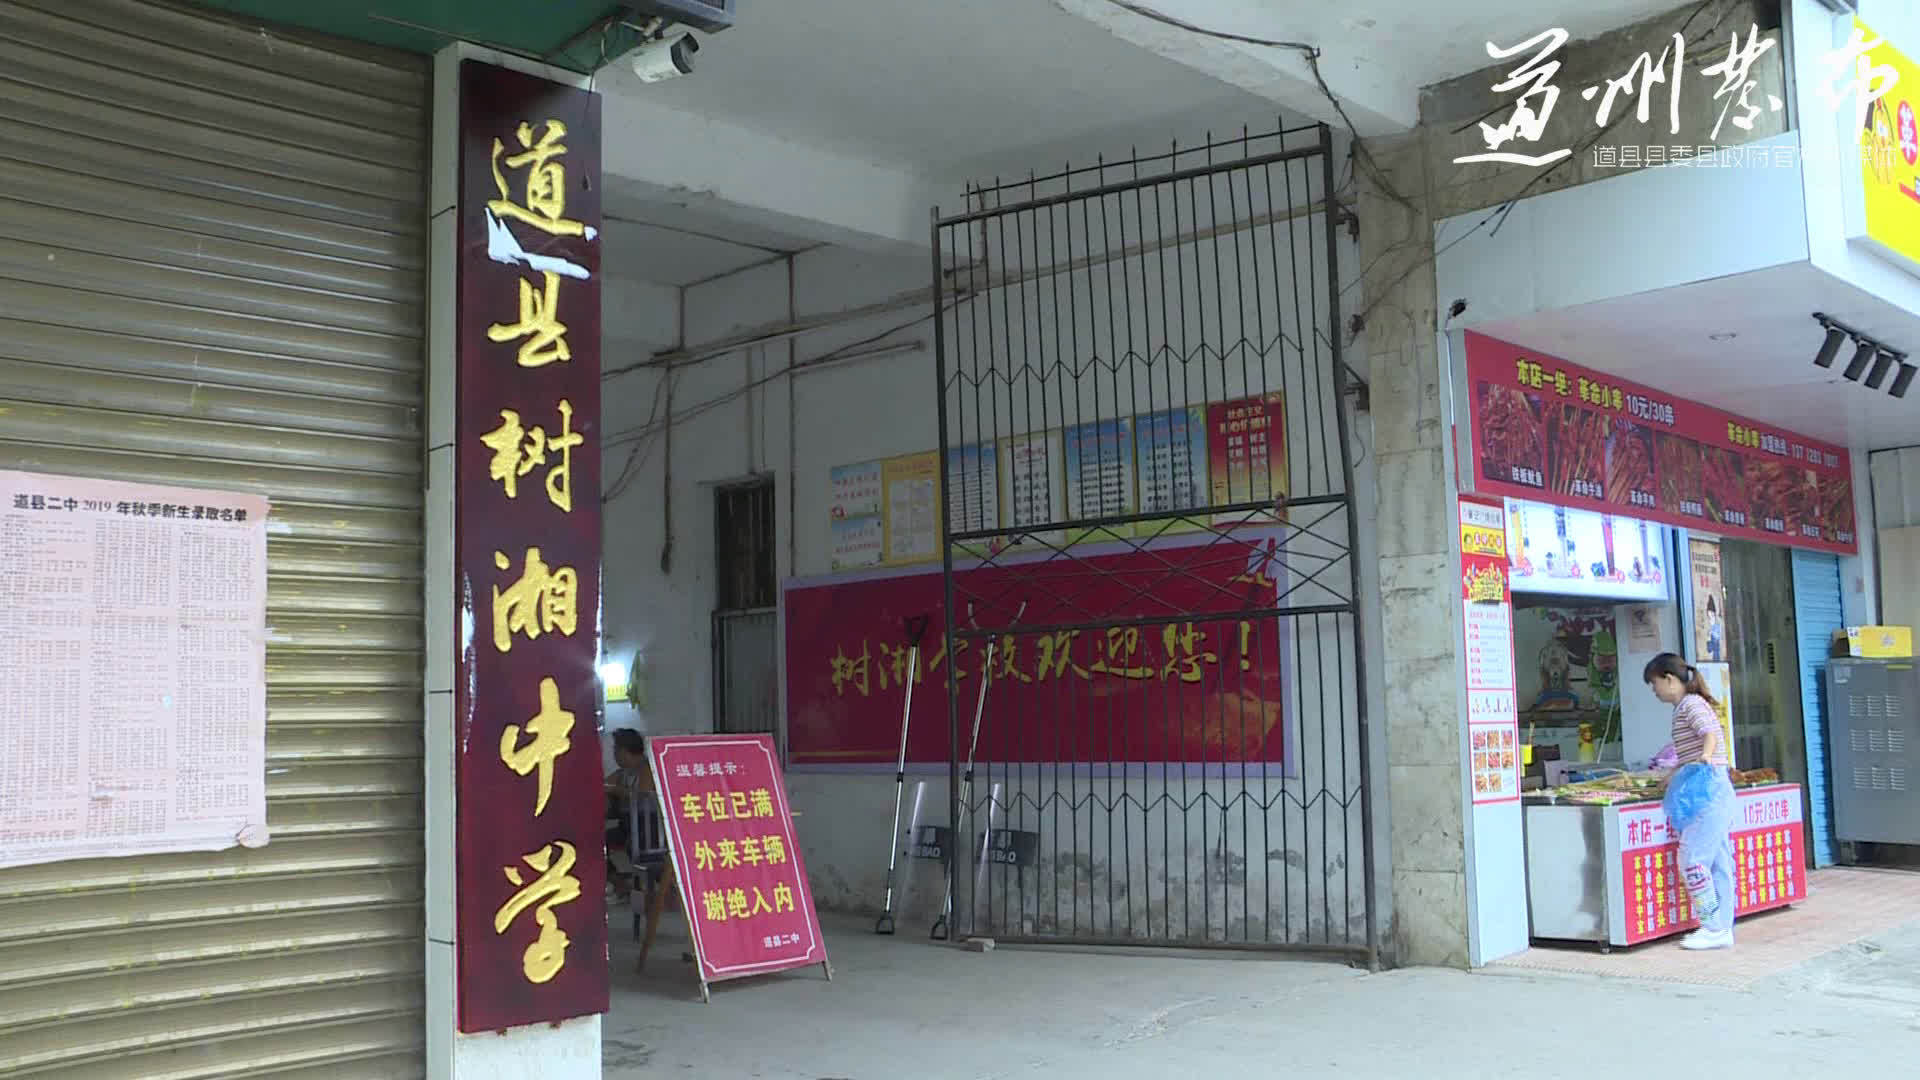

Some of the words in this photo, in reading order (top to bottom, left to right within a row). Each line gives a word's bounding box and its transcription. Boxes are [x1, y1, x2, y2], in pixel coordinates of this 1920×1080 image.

[13, 494, 79, 512] 道县二中
[83, 500, 112, 513] 2019
[116, 501, 248, 522] 年秋季新生录取名单
[480, 119, 598, 984] 道县树湘中学
[680, 788, 774, 823] 车位已满
[694, 835, 786, 872] 外来车辆
[702, 882, 795, 921] 谢绝入内
